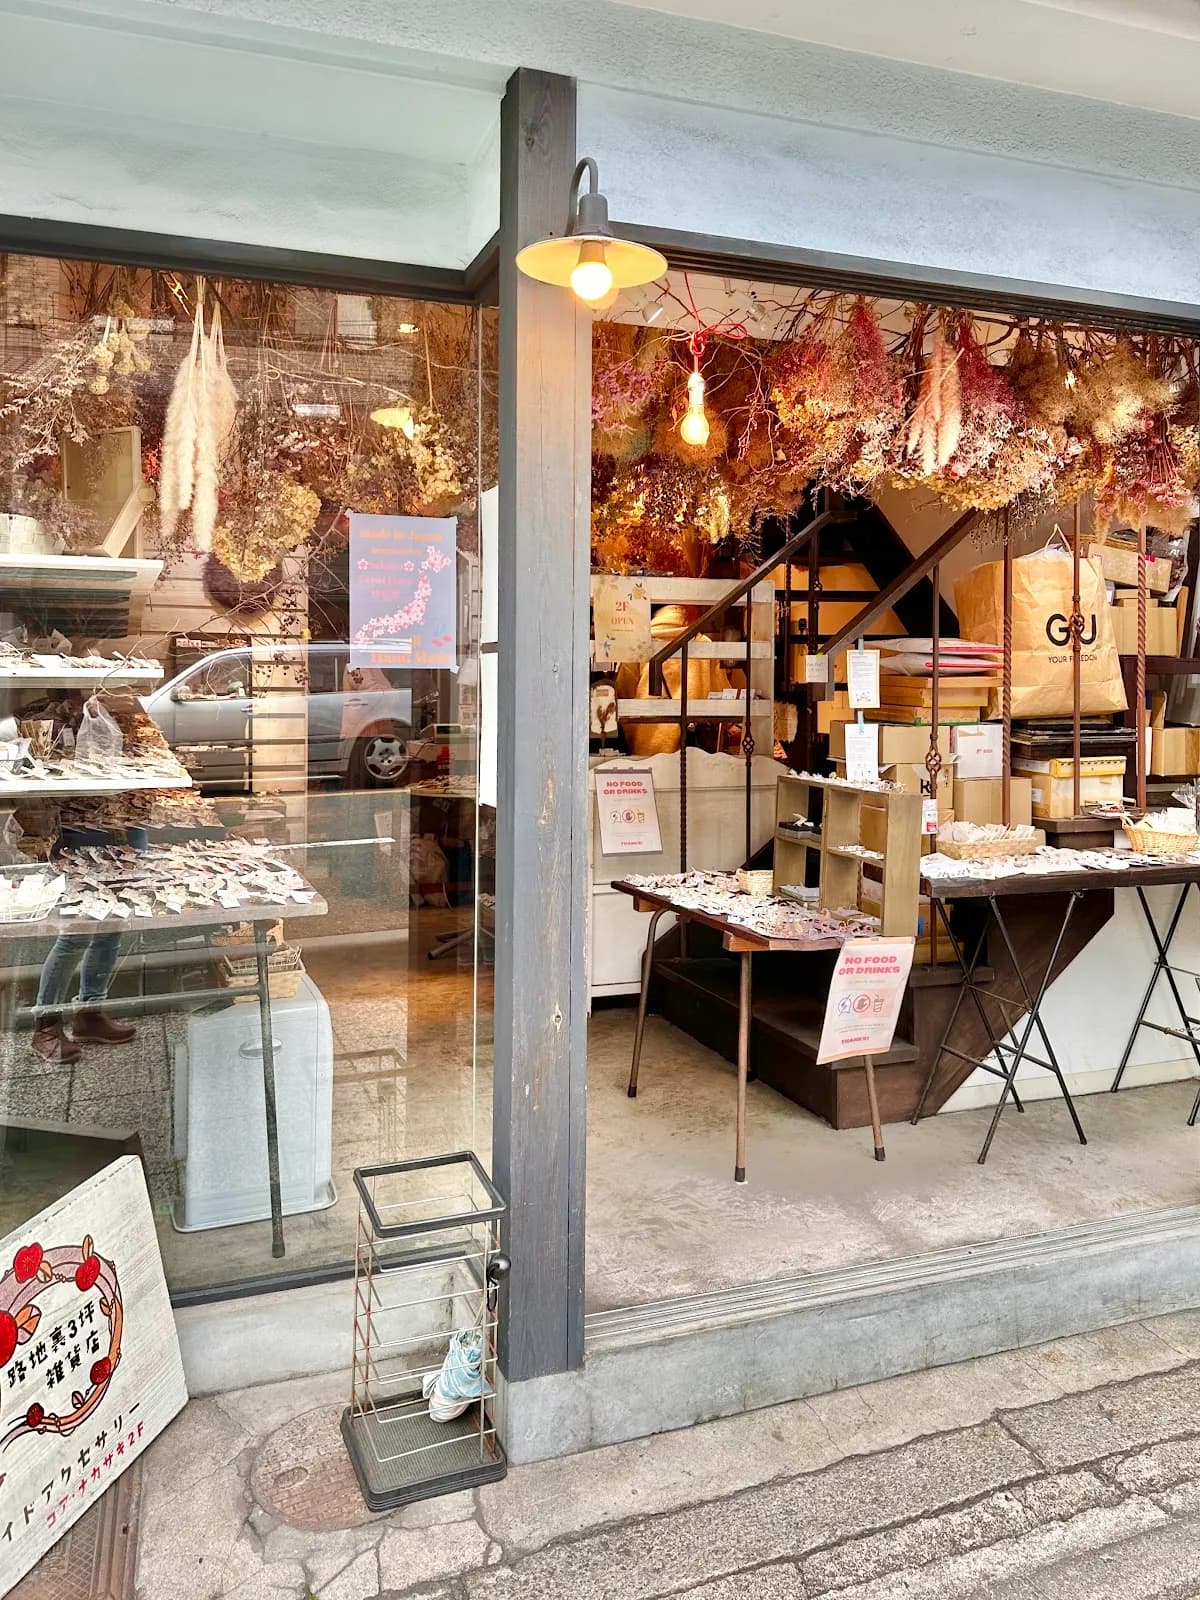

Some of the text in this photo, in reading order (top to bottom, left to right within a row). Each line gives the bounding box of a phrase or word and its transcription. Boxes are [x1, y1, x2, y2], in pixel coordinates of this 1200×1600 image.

[1048, 655, 1067, 663] YOUR
[845, 956, 897, 964] NO FOOD
[838, 966, 900, 976] OR DRINKS
[45, 1330, 100, 1389] 雑貨店
